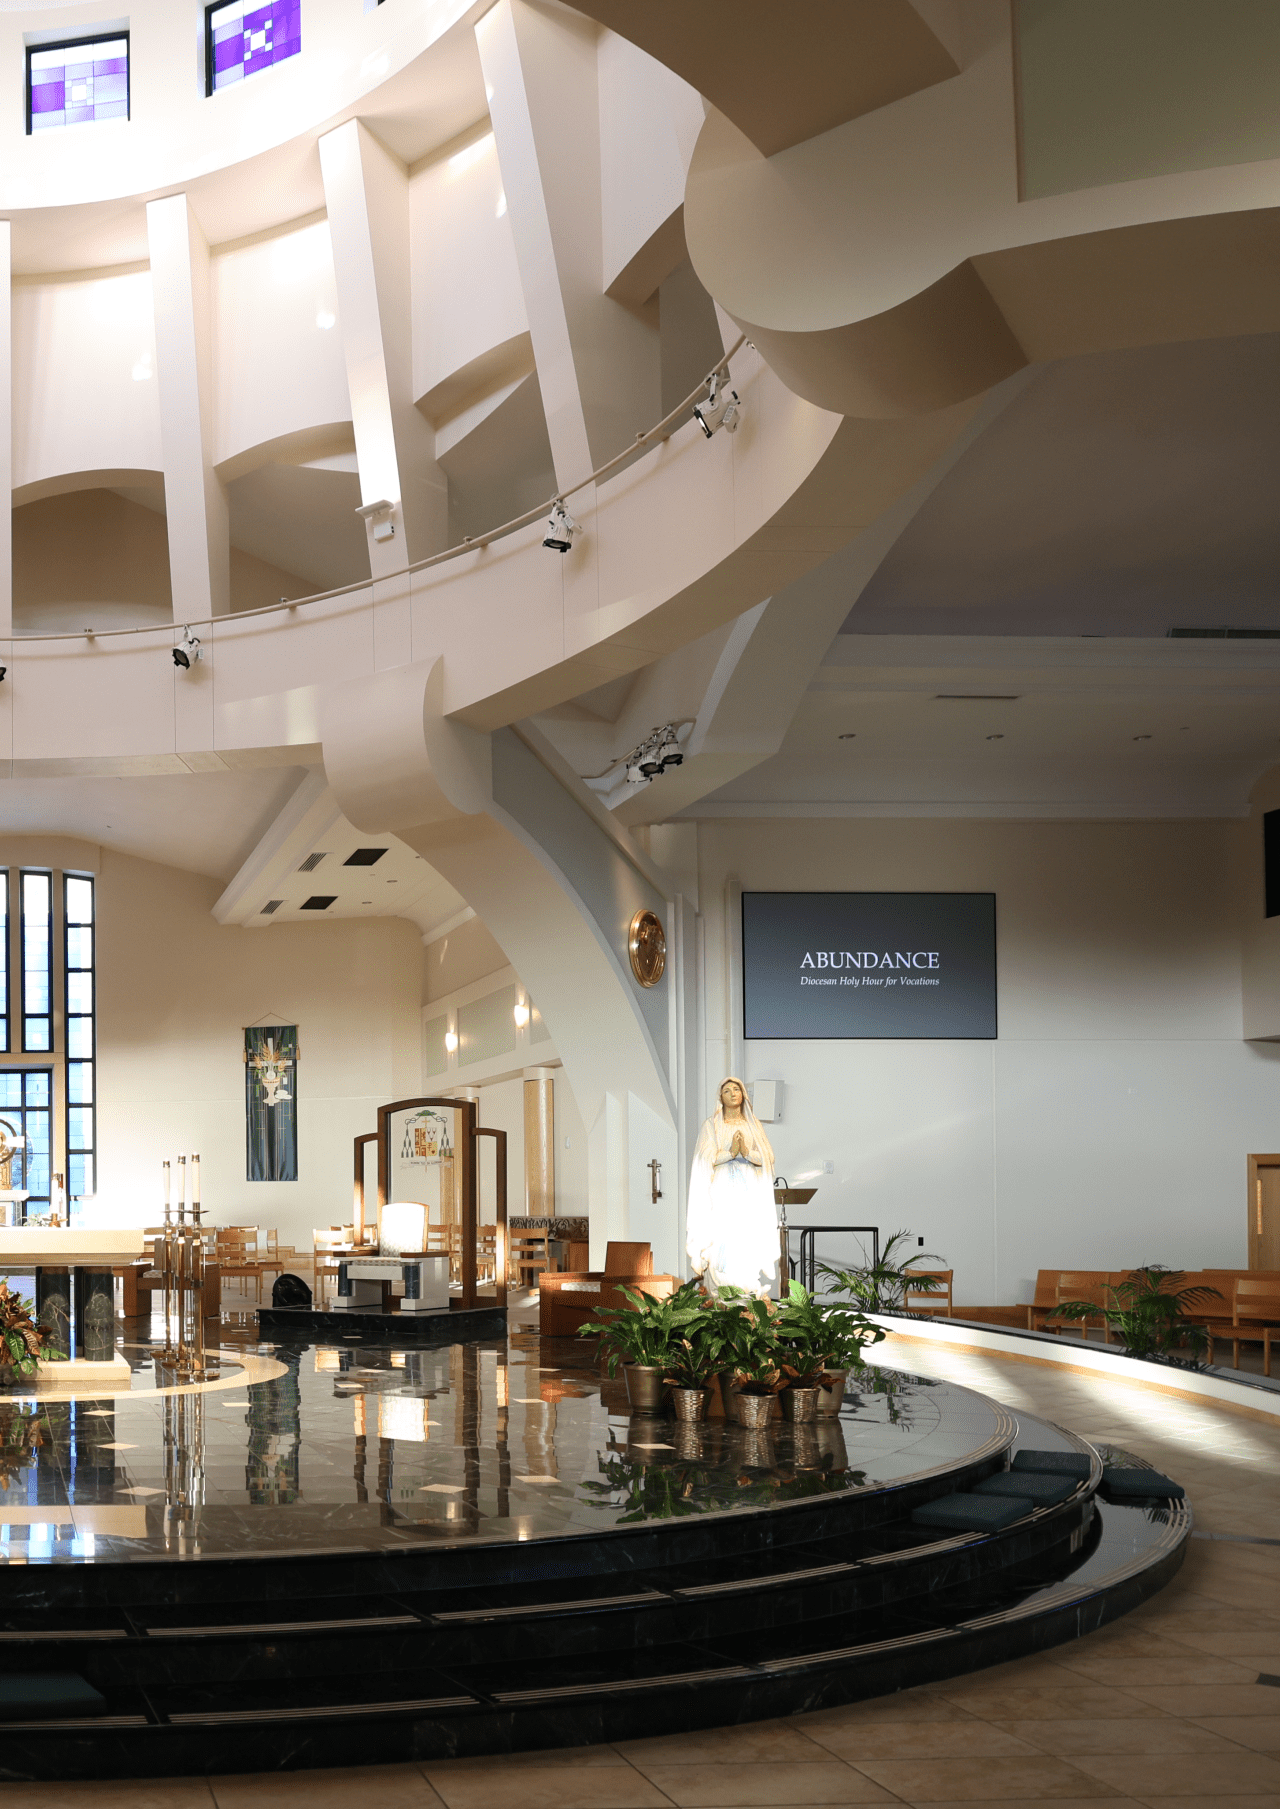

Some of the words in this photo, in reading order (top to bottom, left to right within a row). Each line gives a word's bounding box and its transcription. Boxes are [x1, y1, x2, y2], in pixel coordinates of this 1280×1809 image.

[800, 951, 940, 969] ABUNDANCE
[800, 976, 837, 986] Diocesan
[839, 976, 860, 988] Holy
[862, 976, 884, 986] Hour
[884, 976, 897, 988] for
[900, 976, 940, 986] Vocations
